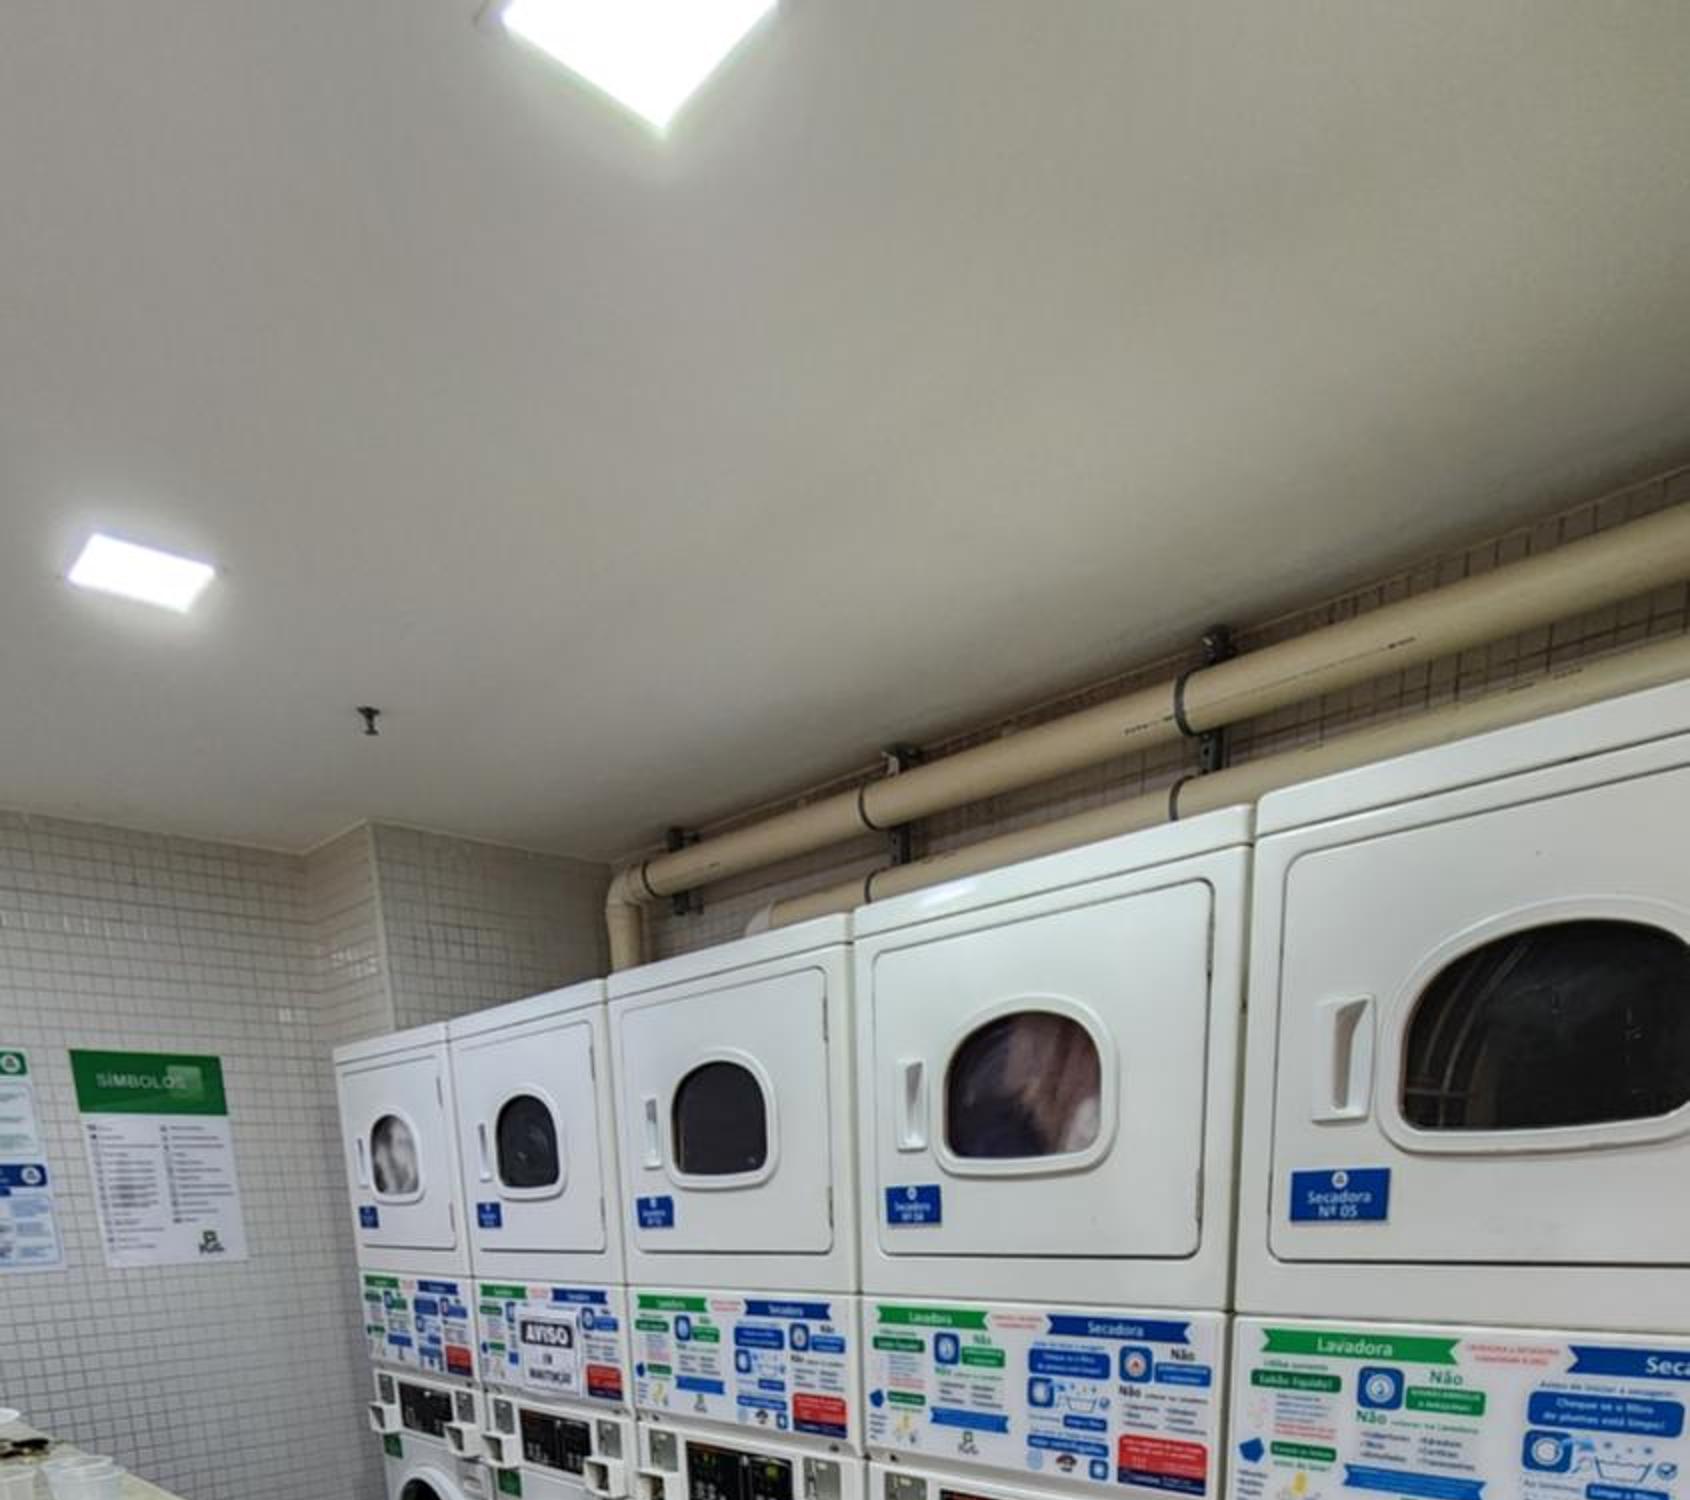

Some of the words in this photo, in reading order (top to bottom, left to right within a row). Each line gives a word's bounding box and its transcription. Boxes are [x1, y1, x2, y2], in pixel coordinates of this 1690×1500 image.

[1307, 1190, 1372, 1204] Secadora
[1340, 1204, 1358, 1217] 05
[526, 1323, 569, 1345] AVISO
[1088, 1320, 1144, 1339] Secadora
[1316, 1336, 1393, 1357] Lavadora
[1170, 1348, 1195, 1362] Não
[1429, 1370, 1463, 1386] Não
[1119, 1385, 1142, 1398] Não
[1556, 1397, 1598, 1412] Cheque
[1356, 1409, 1388, 1425] Não
